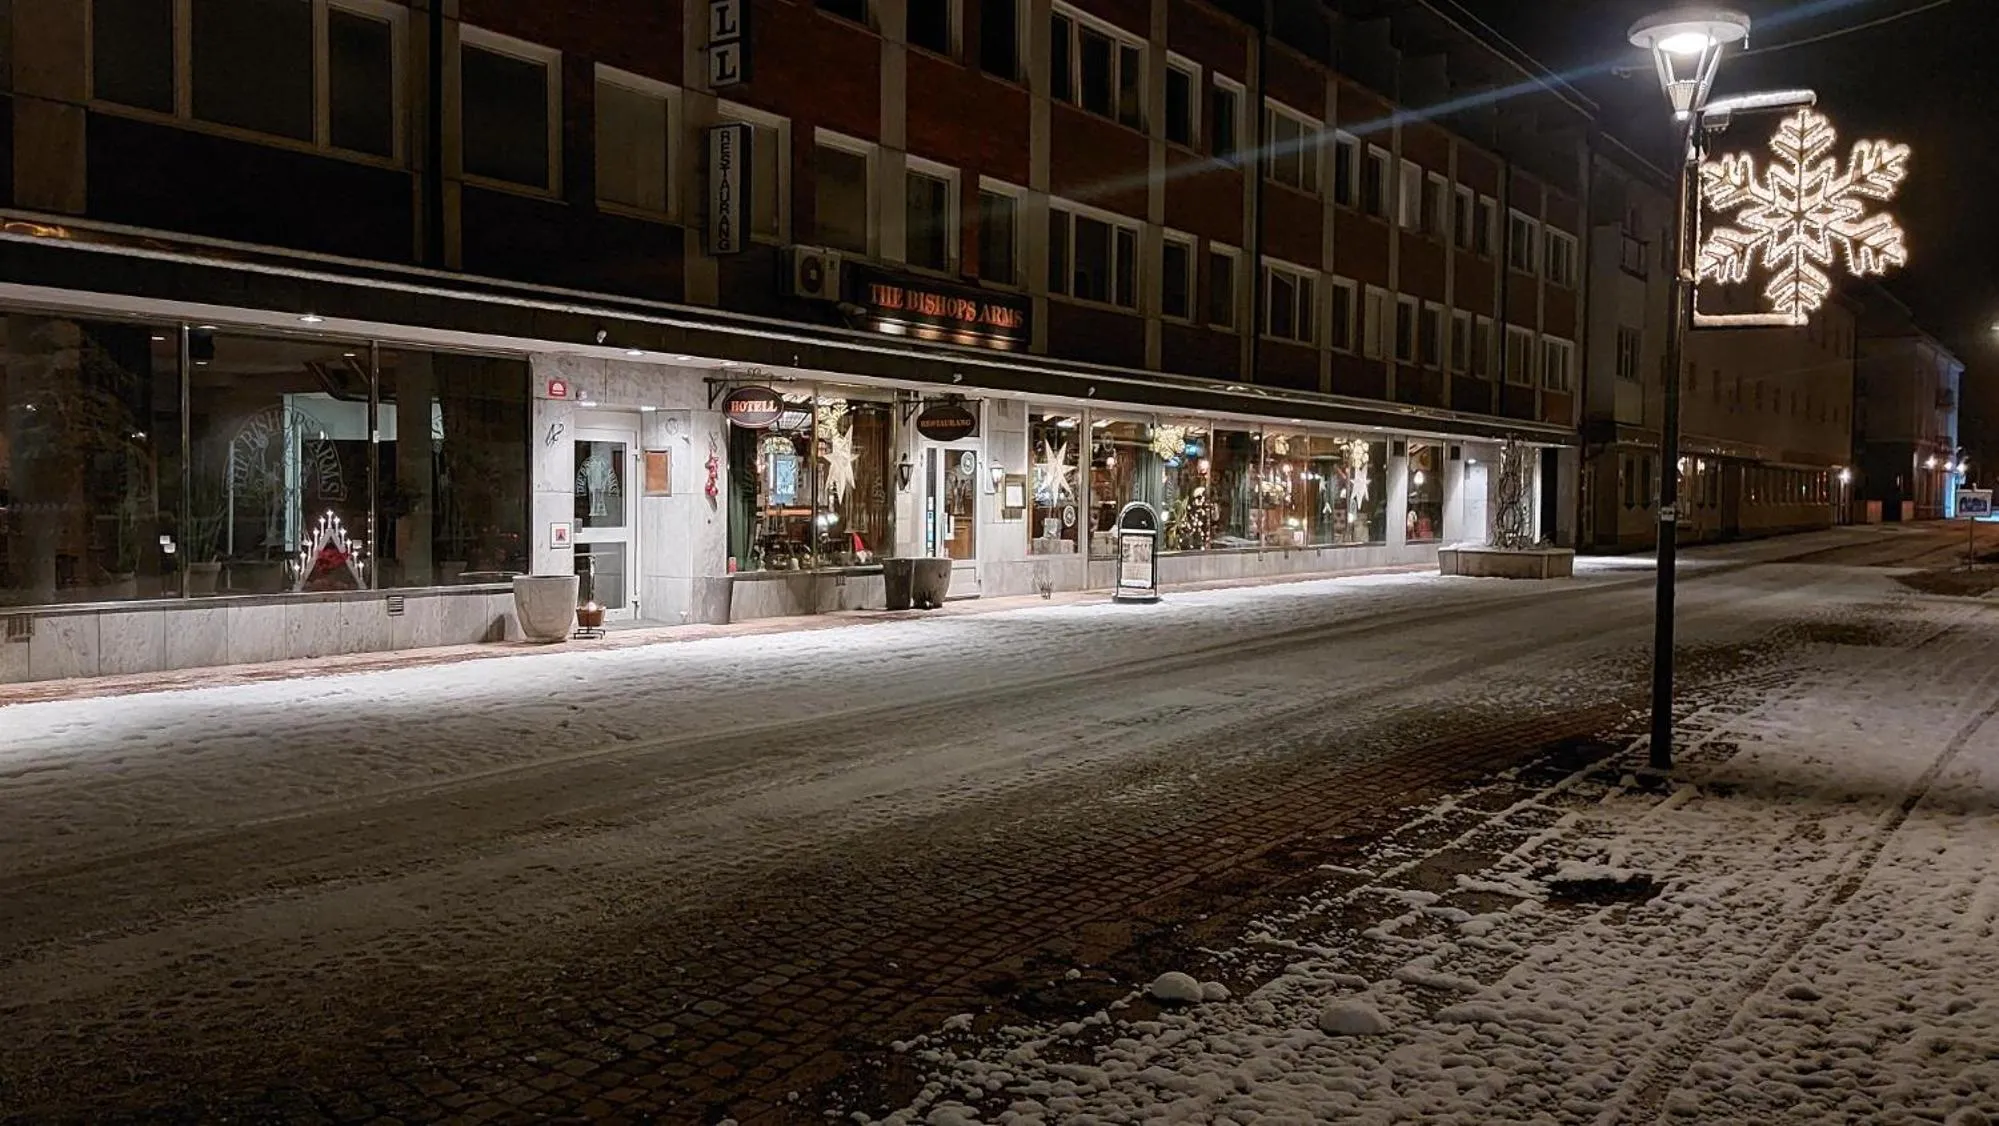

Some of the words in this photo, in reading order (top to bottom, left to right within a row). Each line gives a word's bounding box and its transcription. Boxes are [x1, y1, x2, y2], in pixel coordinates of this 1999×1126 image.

[718, 129, 731, 251] RESTAURANG
[868, 283, 903, 309] THE
[906, 289, 977, 322] BISHOPS
[977, 303, 1024, 328] ARMS
[731, 399, 778, 413] HOTELL
